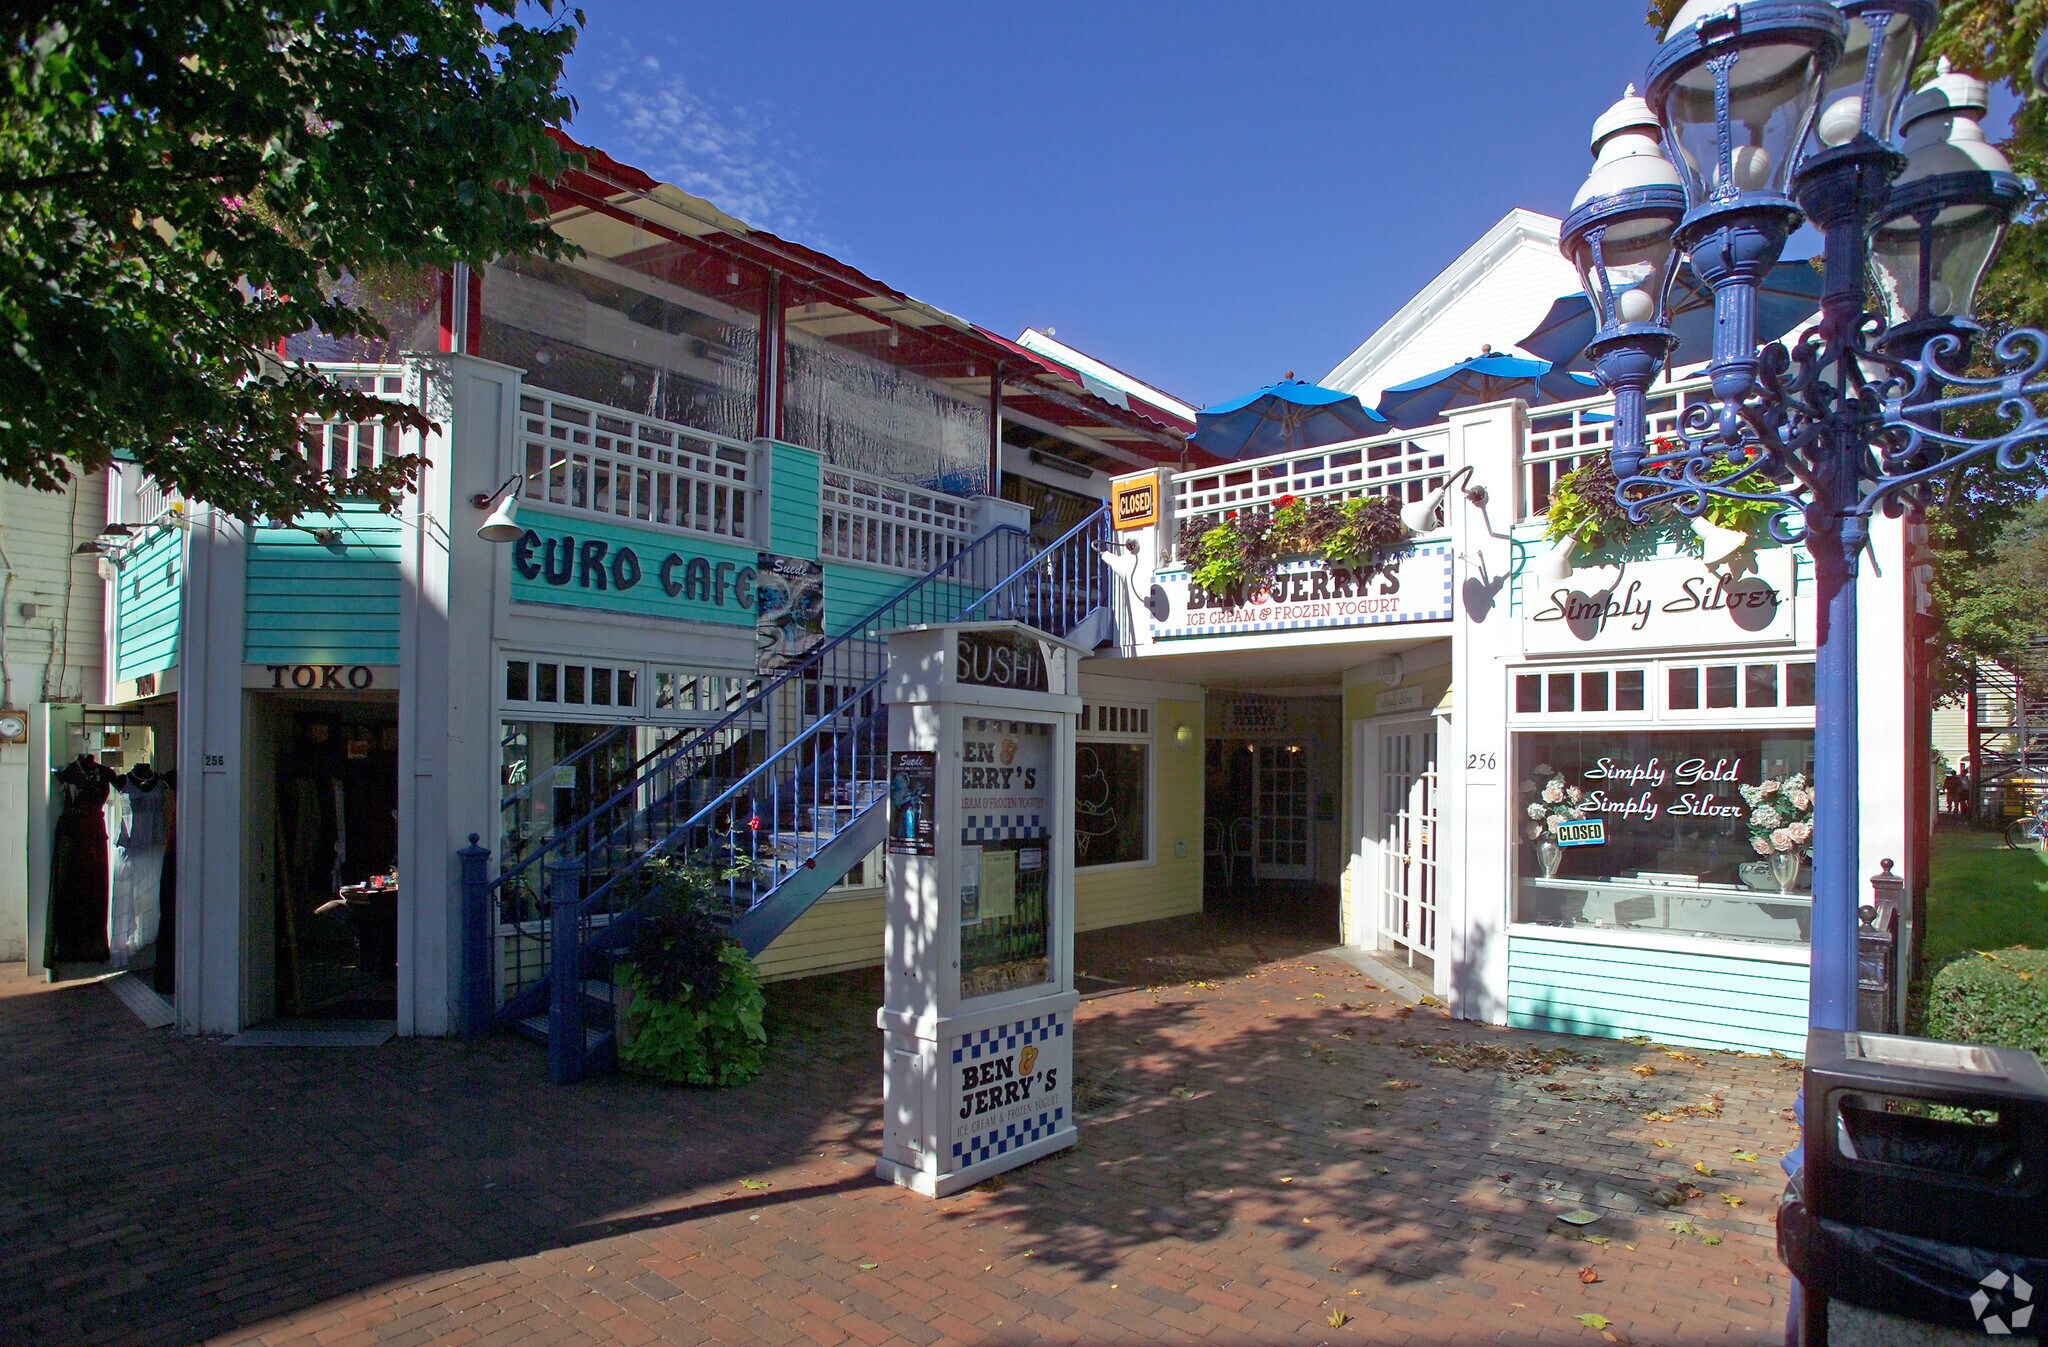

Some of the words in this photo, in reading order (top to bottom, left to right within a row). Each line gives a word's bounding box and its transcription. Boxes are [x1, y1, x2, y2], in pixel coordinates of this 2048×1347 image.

[1120, 492, 1150, 515] CLOSED
[515, 528, 642, 591] EURO
[661, 552, 757, 609] CAFE
[773, 559, 808, 577] Suede
[1275, 564, 1400, 603] JERRY'S
[1187, 612, 1205, 626] ICE
[1209, 609, 1255, 624] CREAM
[1259, 606, 1272, 620] &
[1274, 603, 1331, 619] FROZEN
[1336, 598, 1400, 616] YOGURT
[1533, 580, 1651, 633] Simply
[1662, 573, 1782, 613] Silver
[267, 664, 373, 689] TOKO
[957, 641, 1039, 687] SUSHI
[205, 755, 224, 767] 256
[900, 754, 924, 766] Suede
[963, 741, 995, 763] EN
[1467, 752, 1496, 770] 256
[962, 766, 1036, 789] ERRY'S
[1584, 757, 1666, 788] Simply
[1675, 757, 1741, 786] Gold
[990, 797, 1018, 809] FROZEN
[1578, 790, 1659, 820] Simply
[1666, 793, 1743, 818] Silver
[1558, 824, 1602, 842] CLOSED
[962, 1055, 1014, 1091] BEN
[959, 1068, 1057, 1119] JERRY'S
[957, 1123, 968, 1139] ICE
[972, 1115, 996, 1133] CREAM
[999, 1112, 1005, 1123] &
[1007, 1104, 1032, 1121] FROZEN
[1035, 1094, 1059, 1111] YOGURT
